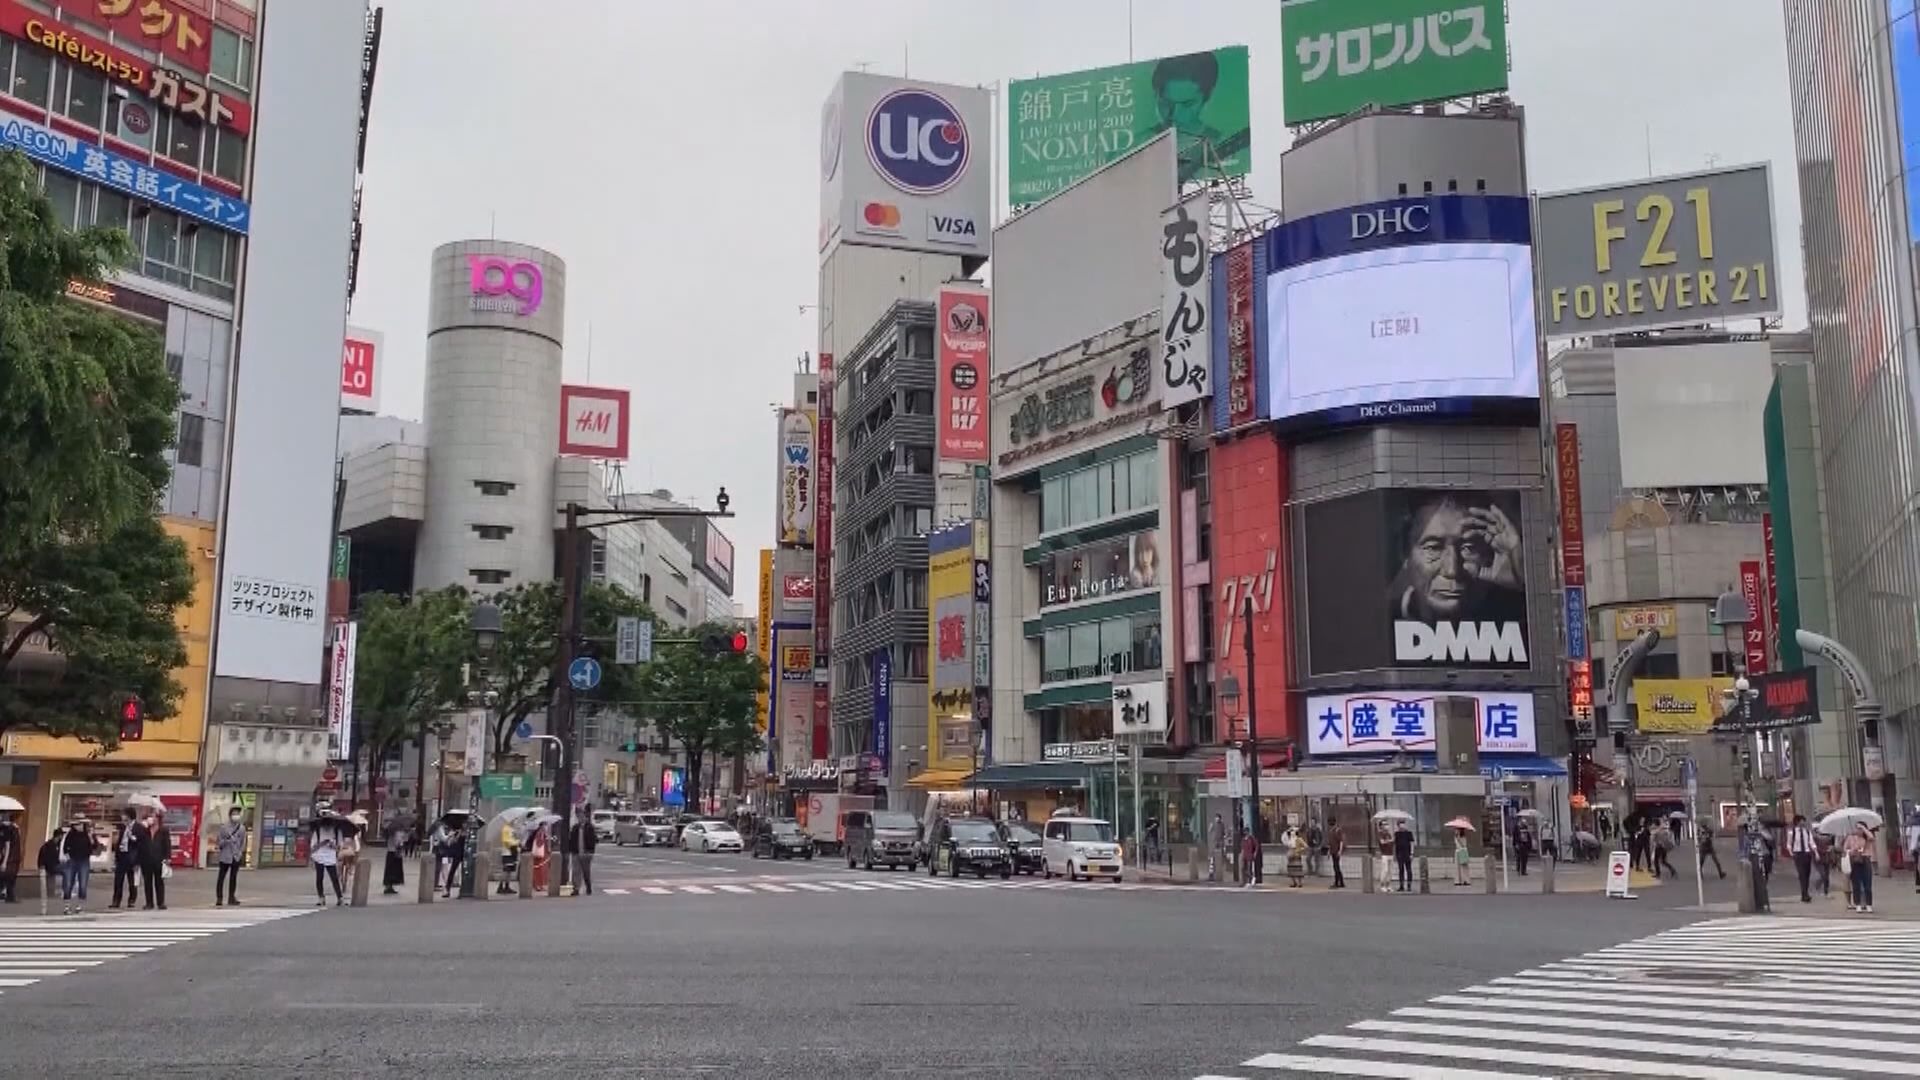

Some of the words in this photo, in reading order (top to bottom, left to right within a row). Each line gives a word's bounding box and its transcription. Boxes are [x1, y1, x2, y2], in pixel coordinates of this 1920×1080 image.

[1296, 6, 1491, 82] サロンパス
[150, 68, 233, 125] ガスト
[1019, 77, 1133, 122] 錦戸亮
[5, 122, 67, 159] AEON
[880, 113, 959, 166] UC
[1103, 114, 1133, 129] 2019
[1021, 129, 1133, 164] NOMAD
[934, 216, 975, 236] VISA
[1351, 205, 1430, 239] DHC
[1593, 188, 1713, 272] F21
[470, 255, 543, 317] 109
[1163, 207, 1206, 390] もんじゃ
[1552, 270, 1718, 323] FOREVER
[1729, 263, 1768, 303] 21
[1360, 405, 1387, 417] DHC
[1388, 400, 1436, 415] Channel
[232, 597, 313, 620] デザイン製作中
[1047, 574, 1125, 602] Euphoria
[1394, 620, 1528, 662] DMM
